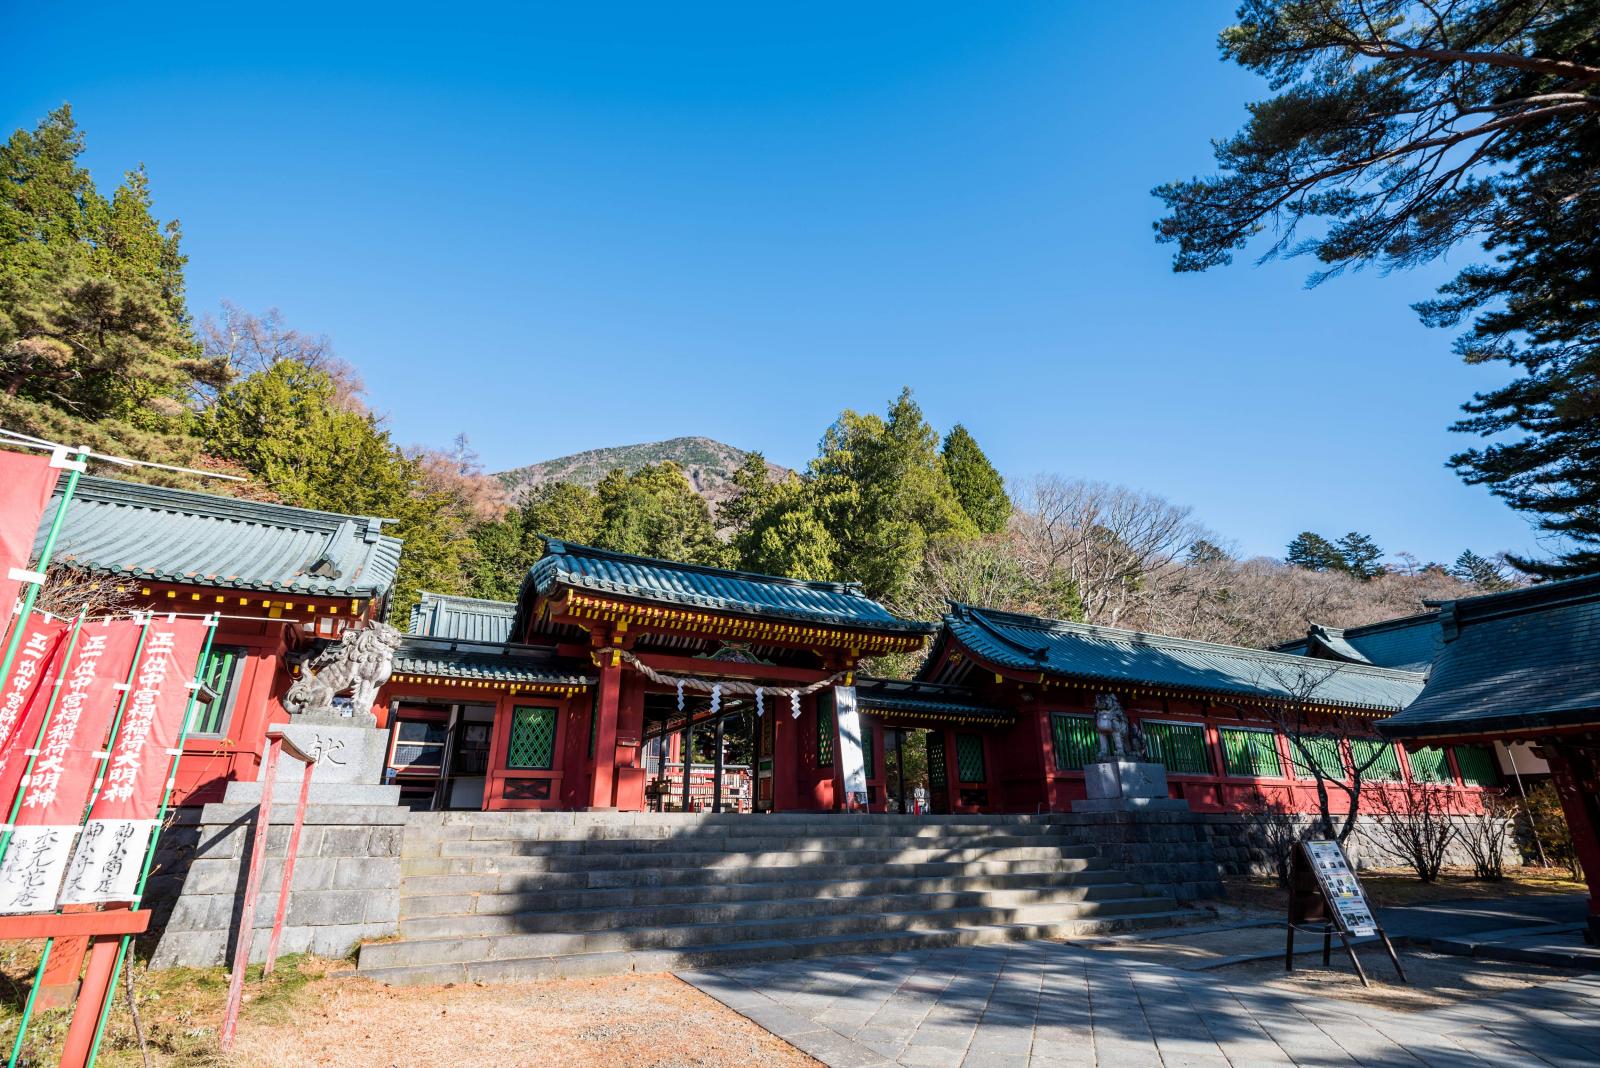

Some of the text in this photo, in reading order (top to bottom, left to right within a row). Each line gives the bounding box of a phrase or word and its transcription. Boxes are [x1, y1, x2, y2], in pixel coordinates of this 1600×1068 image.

[22, 635, 107, 809] 正一位中宮祠稲荷大明神
[101, 632, 176, 803] 正一位中宮祠稲荷大明神
